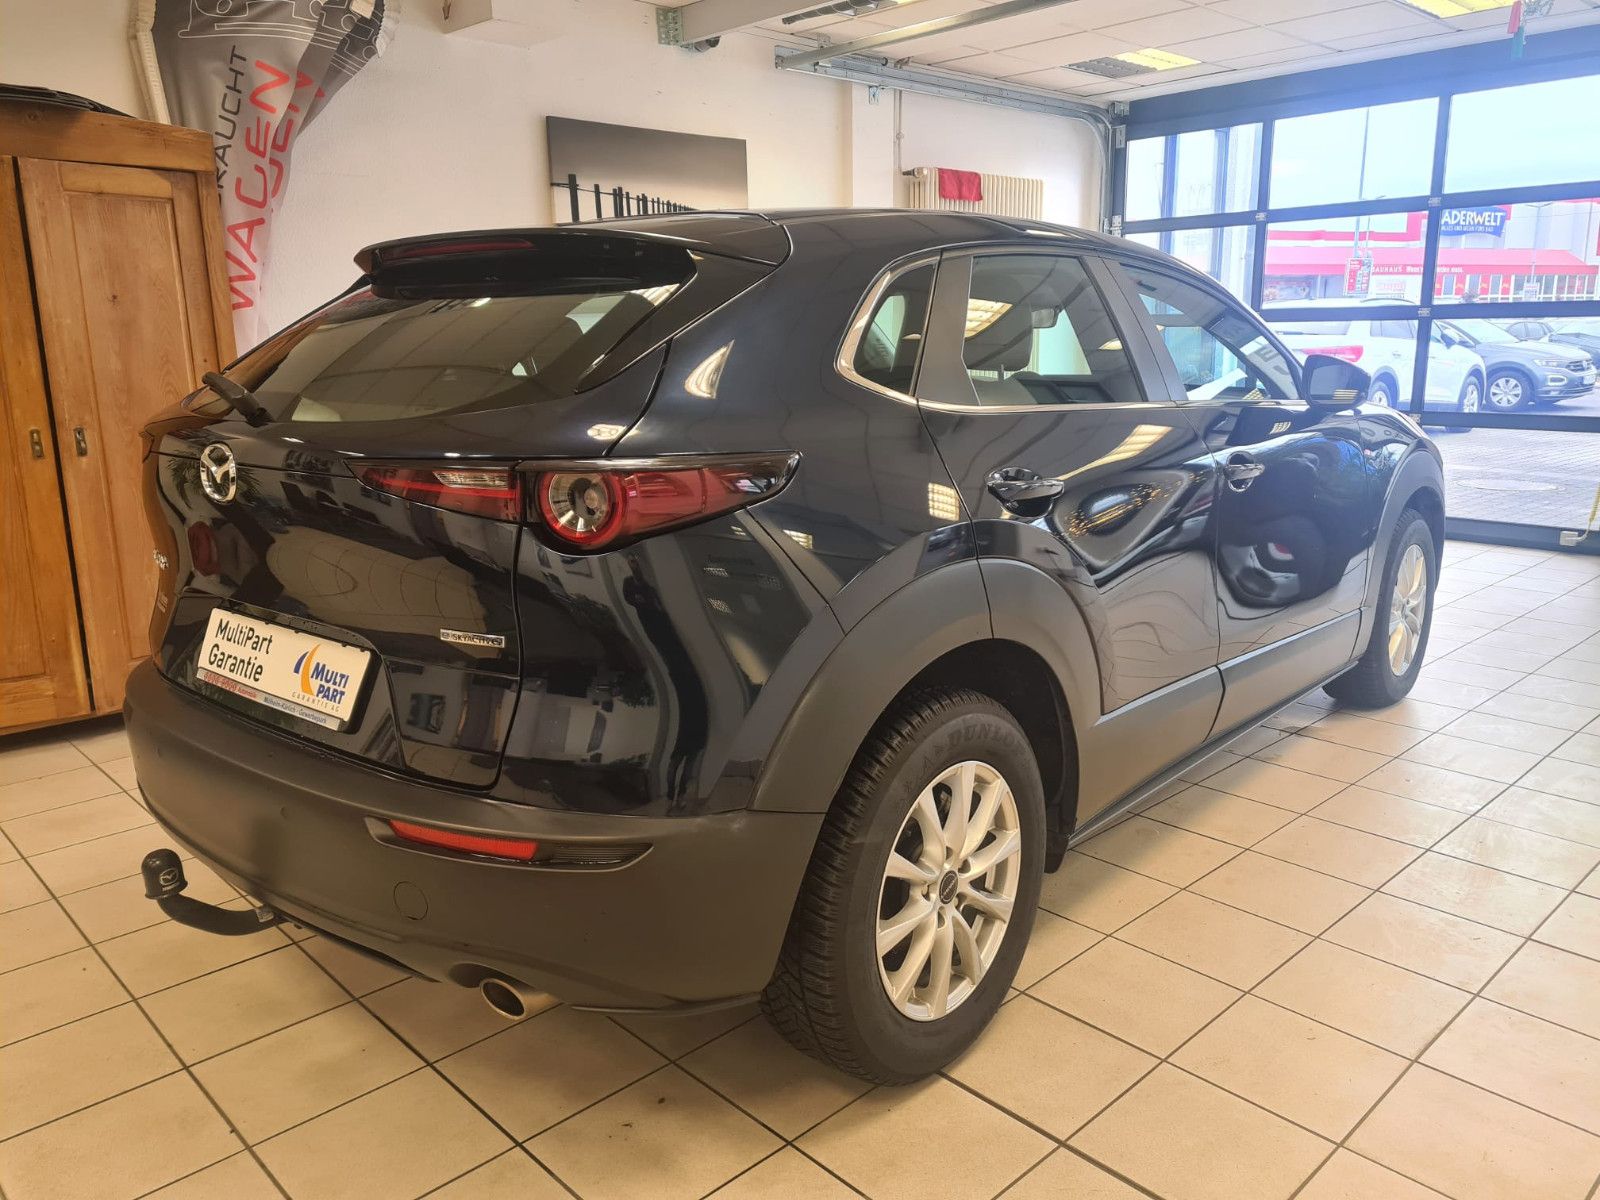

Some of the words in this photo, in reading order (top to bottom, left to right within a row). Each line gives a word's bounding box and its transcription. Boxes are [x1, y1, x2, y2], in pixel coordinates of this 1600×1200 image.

[214, 44, 247, 203] RAUCHT
[1441, 210, 1504, 226] ADERWELT
[215, 618, 273, 654] MultiPart
[208, 643, 264, 682] Garantie
[316, 683, 345, 705] PART
